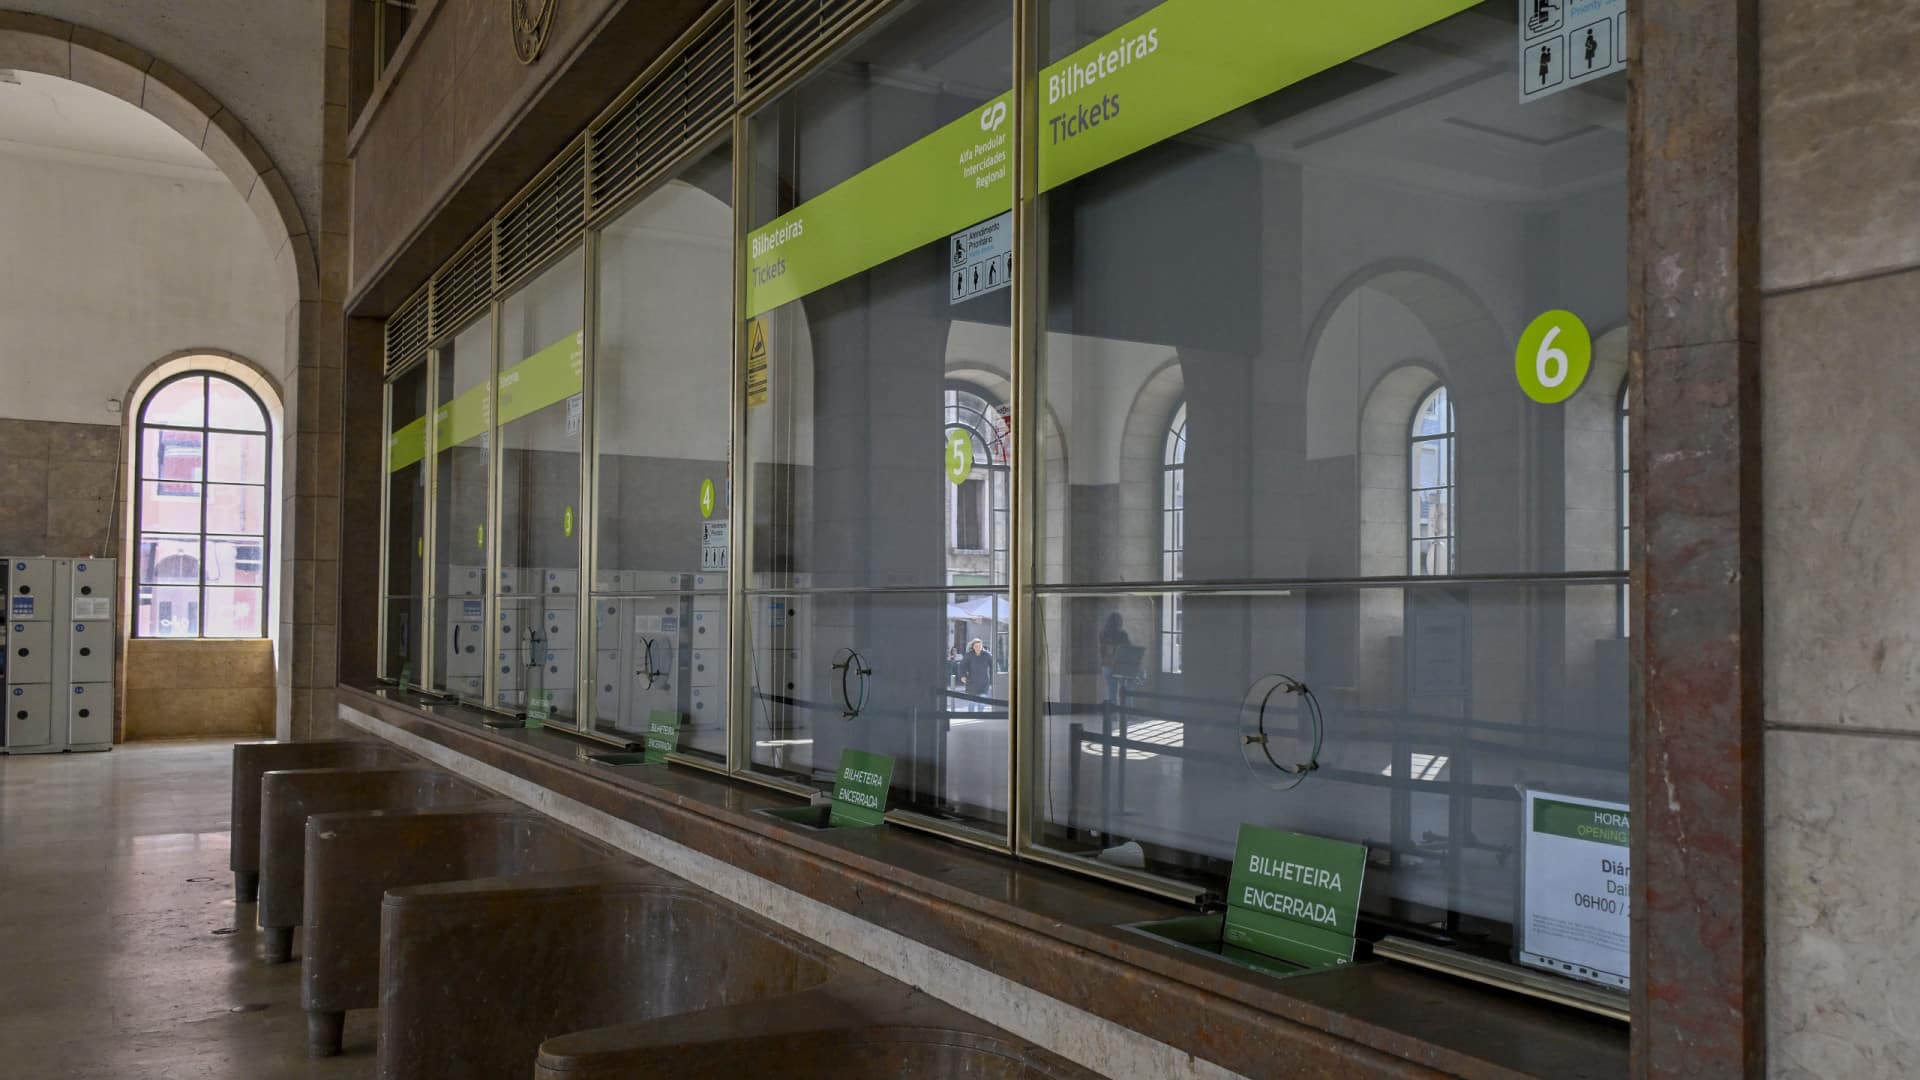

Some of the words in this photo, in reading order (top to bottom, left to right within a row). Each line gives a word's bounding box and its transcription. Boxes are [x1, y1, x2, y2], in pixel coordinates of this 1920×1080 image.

[1049, 27, 1158, 105] Bilheteiras
[1049, 93, 1120, 145] Tickets
[959, 149, 973, 165] Alfa
[975, 133, 1006, 157] Pendular
[963, 151, 1006, 178] Intercidades
[976, 167, 1006, 189] Regional
[752, 219, 804, 259] Bilheteiras
[752, 258, 786, 288] Tickets
[1536, 325, 1569, 388] 6
[952, 439, 965, 476] 5
[703, 485, 712, 511] 4
[843, 767, 882, 788] BILHETEIRA
[838, 788, 878, 809] ENCERRADA
[1577, 824, 1627, 843] OPENING
[1249, 855, 1342, 892] BILHETEIRA
[1243, 886, 1337, 926] ENCERRADA
[1574, 892, 1616, 914] 06H00
